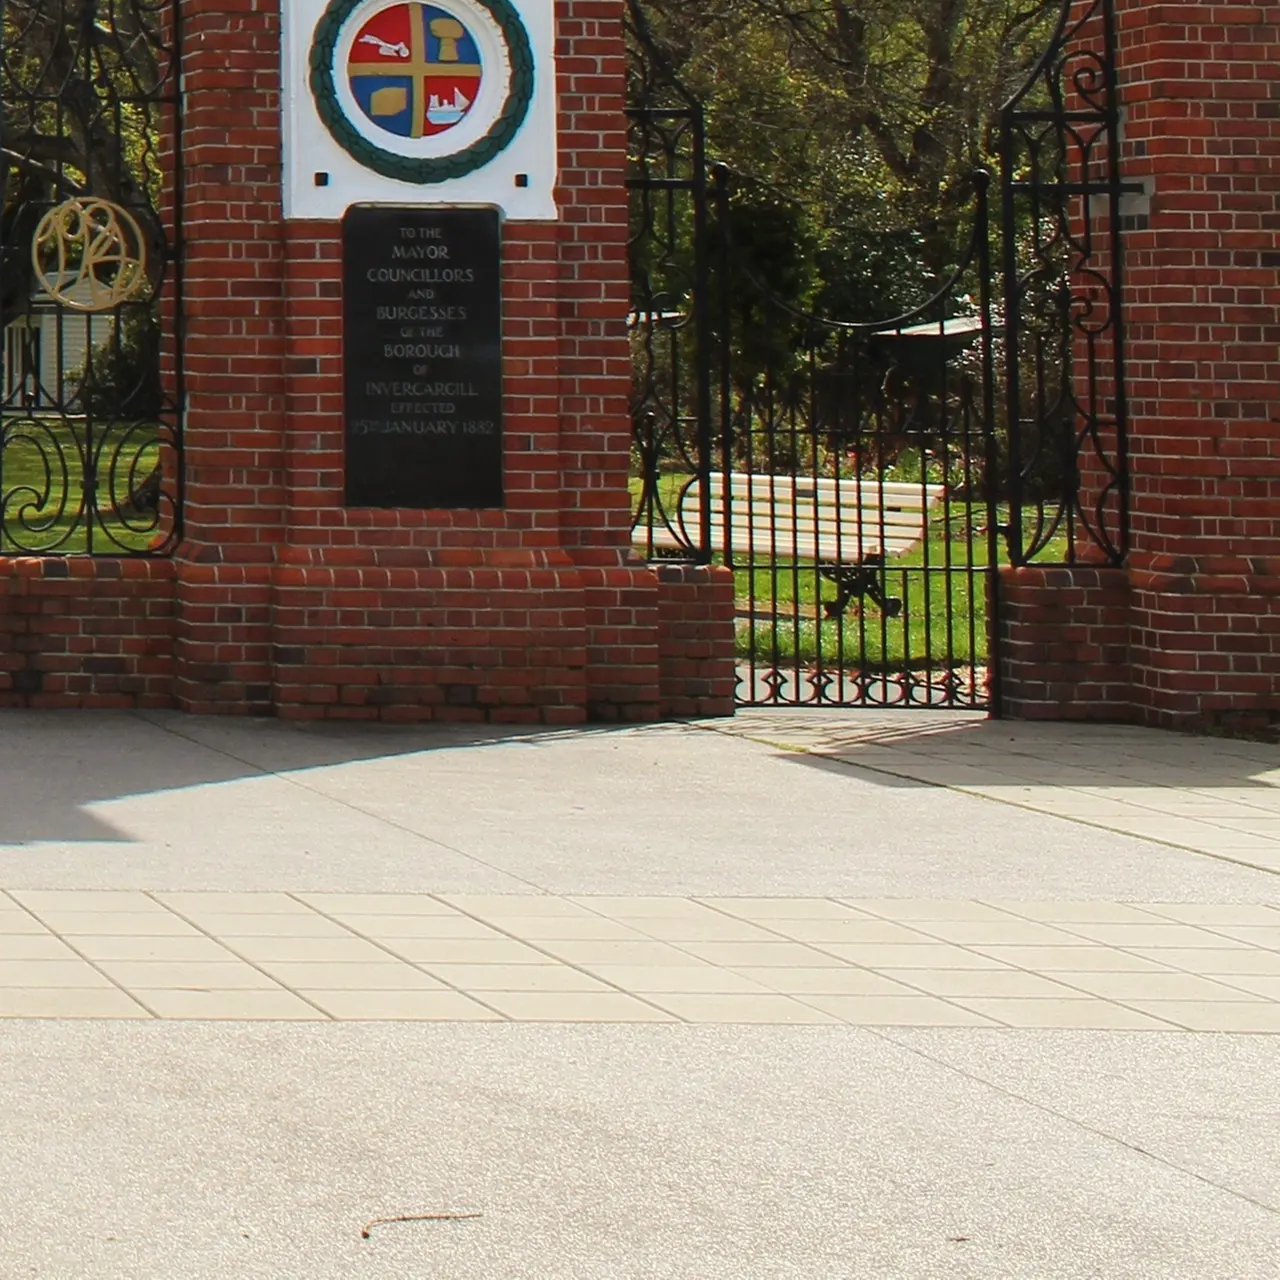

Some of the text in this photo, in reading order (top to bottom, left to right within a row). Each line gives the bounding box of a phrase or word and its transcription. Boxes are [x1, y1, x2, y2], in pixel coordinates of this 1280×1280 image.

[400, 227, 443, 239] TO THE
[391, 245, 451, 259] MAYOR
[366, 268, 475, 282] COUNCILLORS
[407, 289, 436, 300] AND
[376, 306, 468, 320] BURGESSES
[400, 326, 444, 338] OF THE
[383, 344, 461, 358] BOROUGH
[412, 364, 429, 375] OF
[365, 381, 479, 396] INVERCARGILL
[390, 402, 456, 414] EFFECTED
[381, 420, 458, 434] JANUARY
